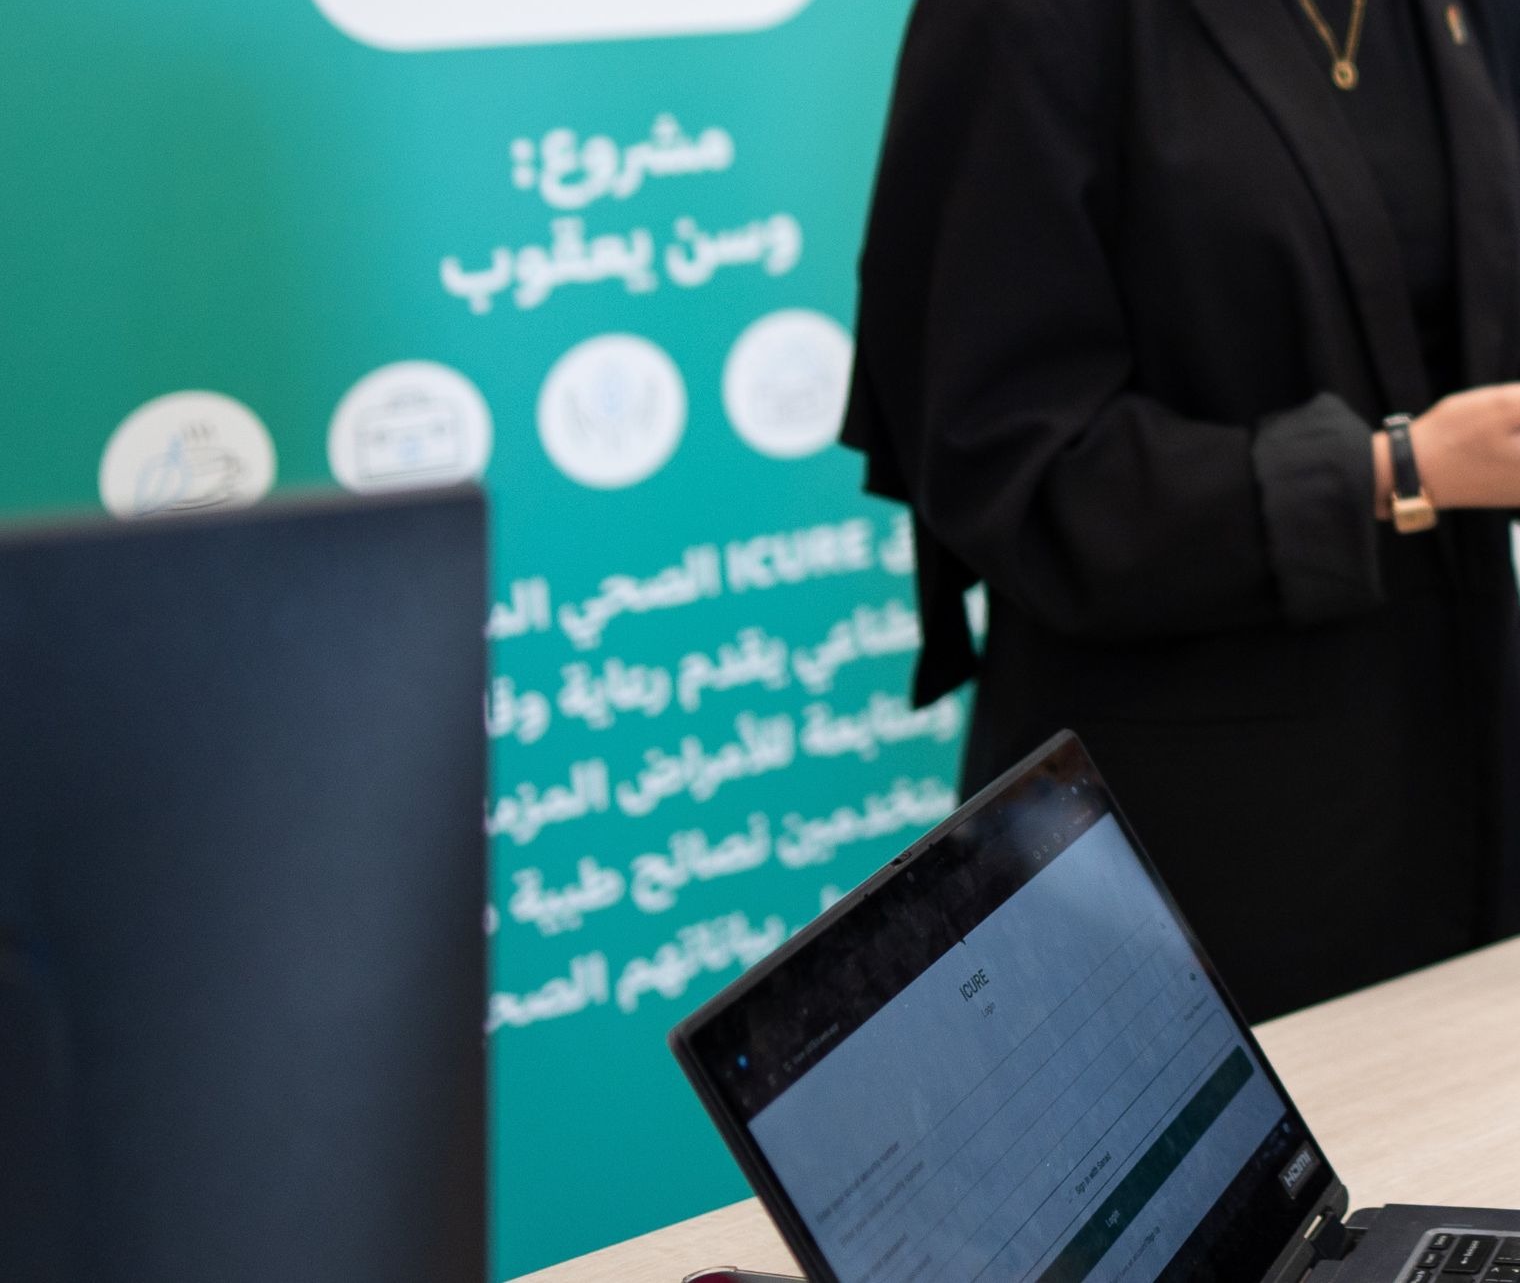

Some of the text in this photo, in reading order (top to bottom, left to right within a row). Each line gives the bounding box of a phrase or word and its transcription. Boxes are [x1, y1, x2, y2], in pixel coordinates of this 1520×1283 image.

[511, 114, 735, 210] مشروع:
[440, 213, 803, 315] وسن يعقوب
[559, 545, 722, 650] الصحي
[725, 518, 875, 592] ICURE
[959, 968, 990, 1003] ICURE
